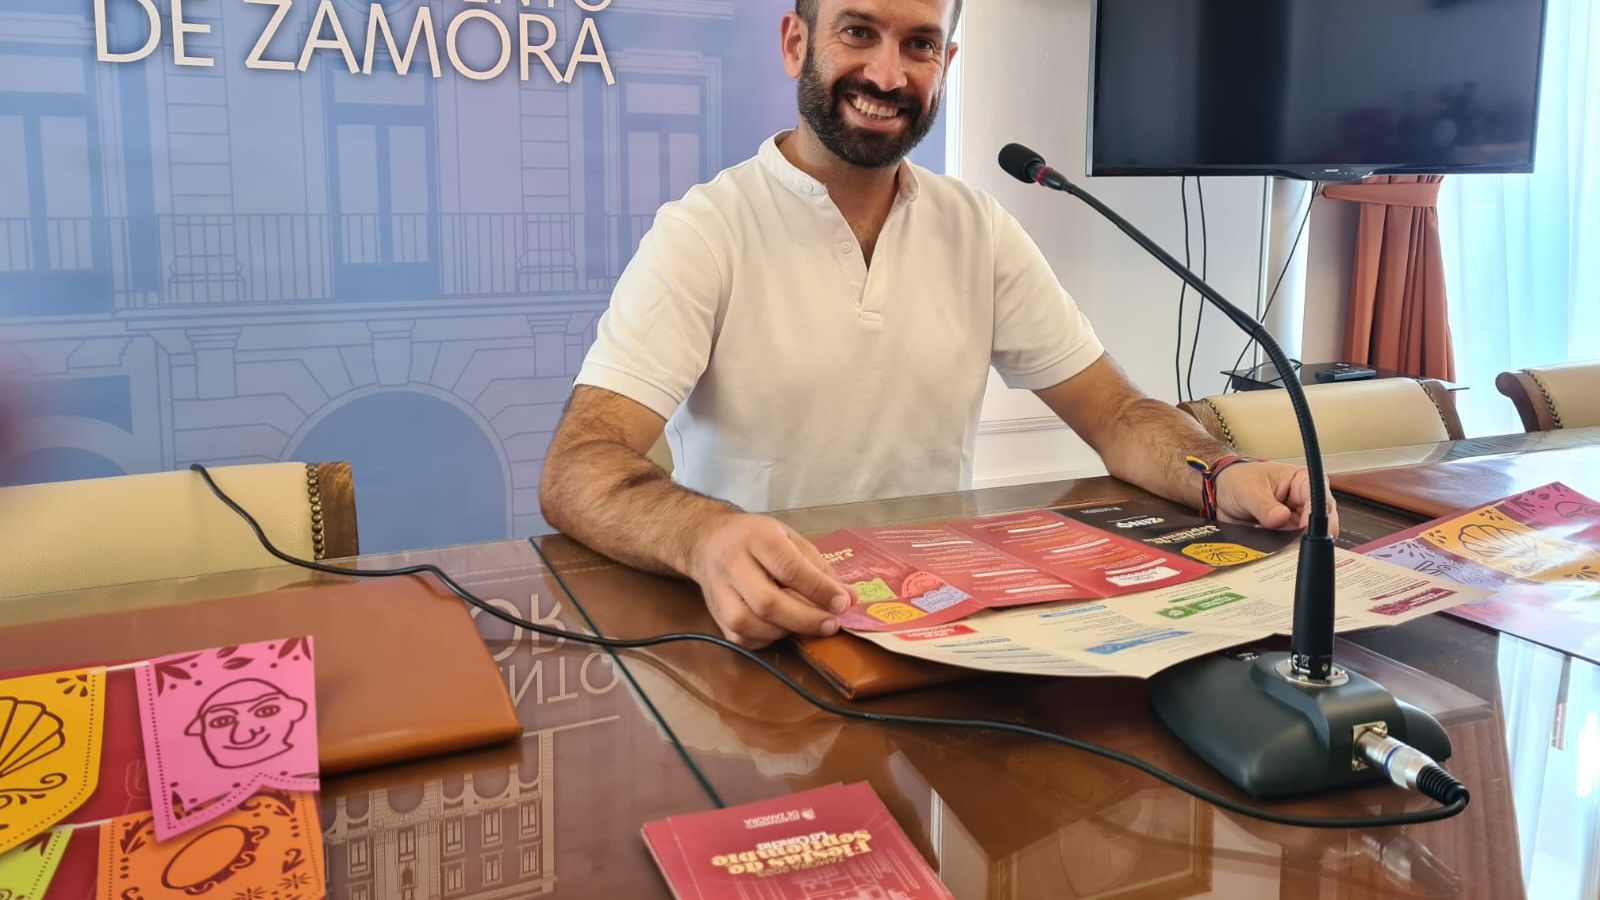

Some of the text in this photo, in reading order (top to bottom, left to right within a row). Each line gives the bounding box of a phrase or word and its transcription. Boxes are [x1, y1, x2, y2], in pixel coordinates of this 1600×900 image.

[95, 0, 616, 86] DE ZAMORA
[711, 829, 872, 867] Septiembre
[728, 840, 872, 875] Fiestas de
